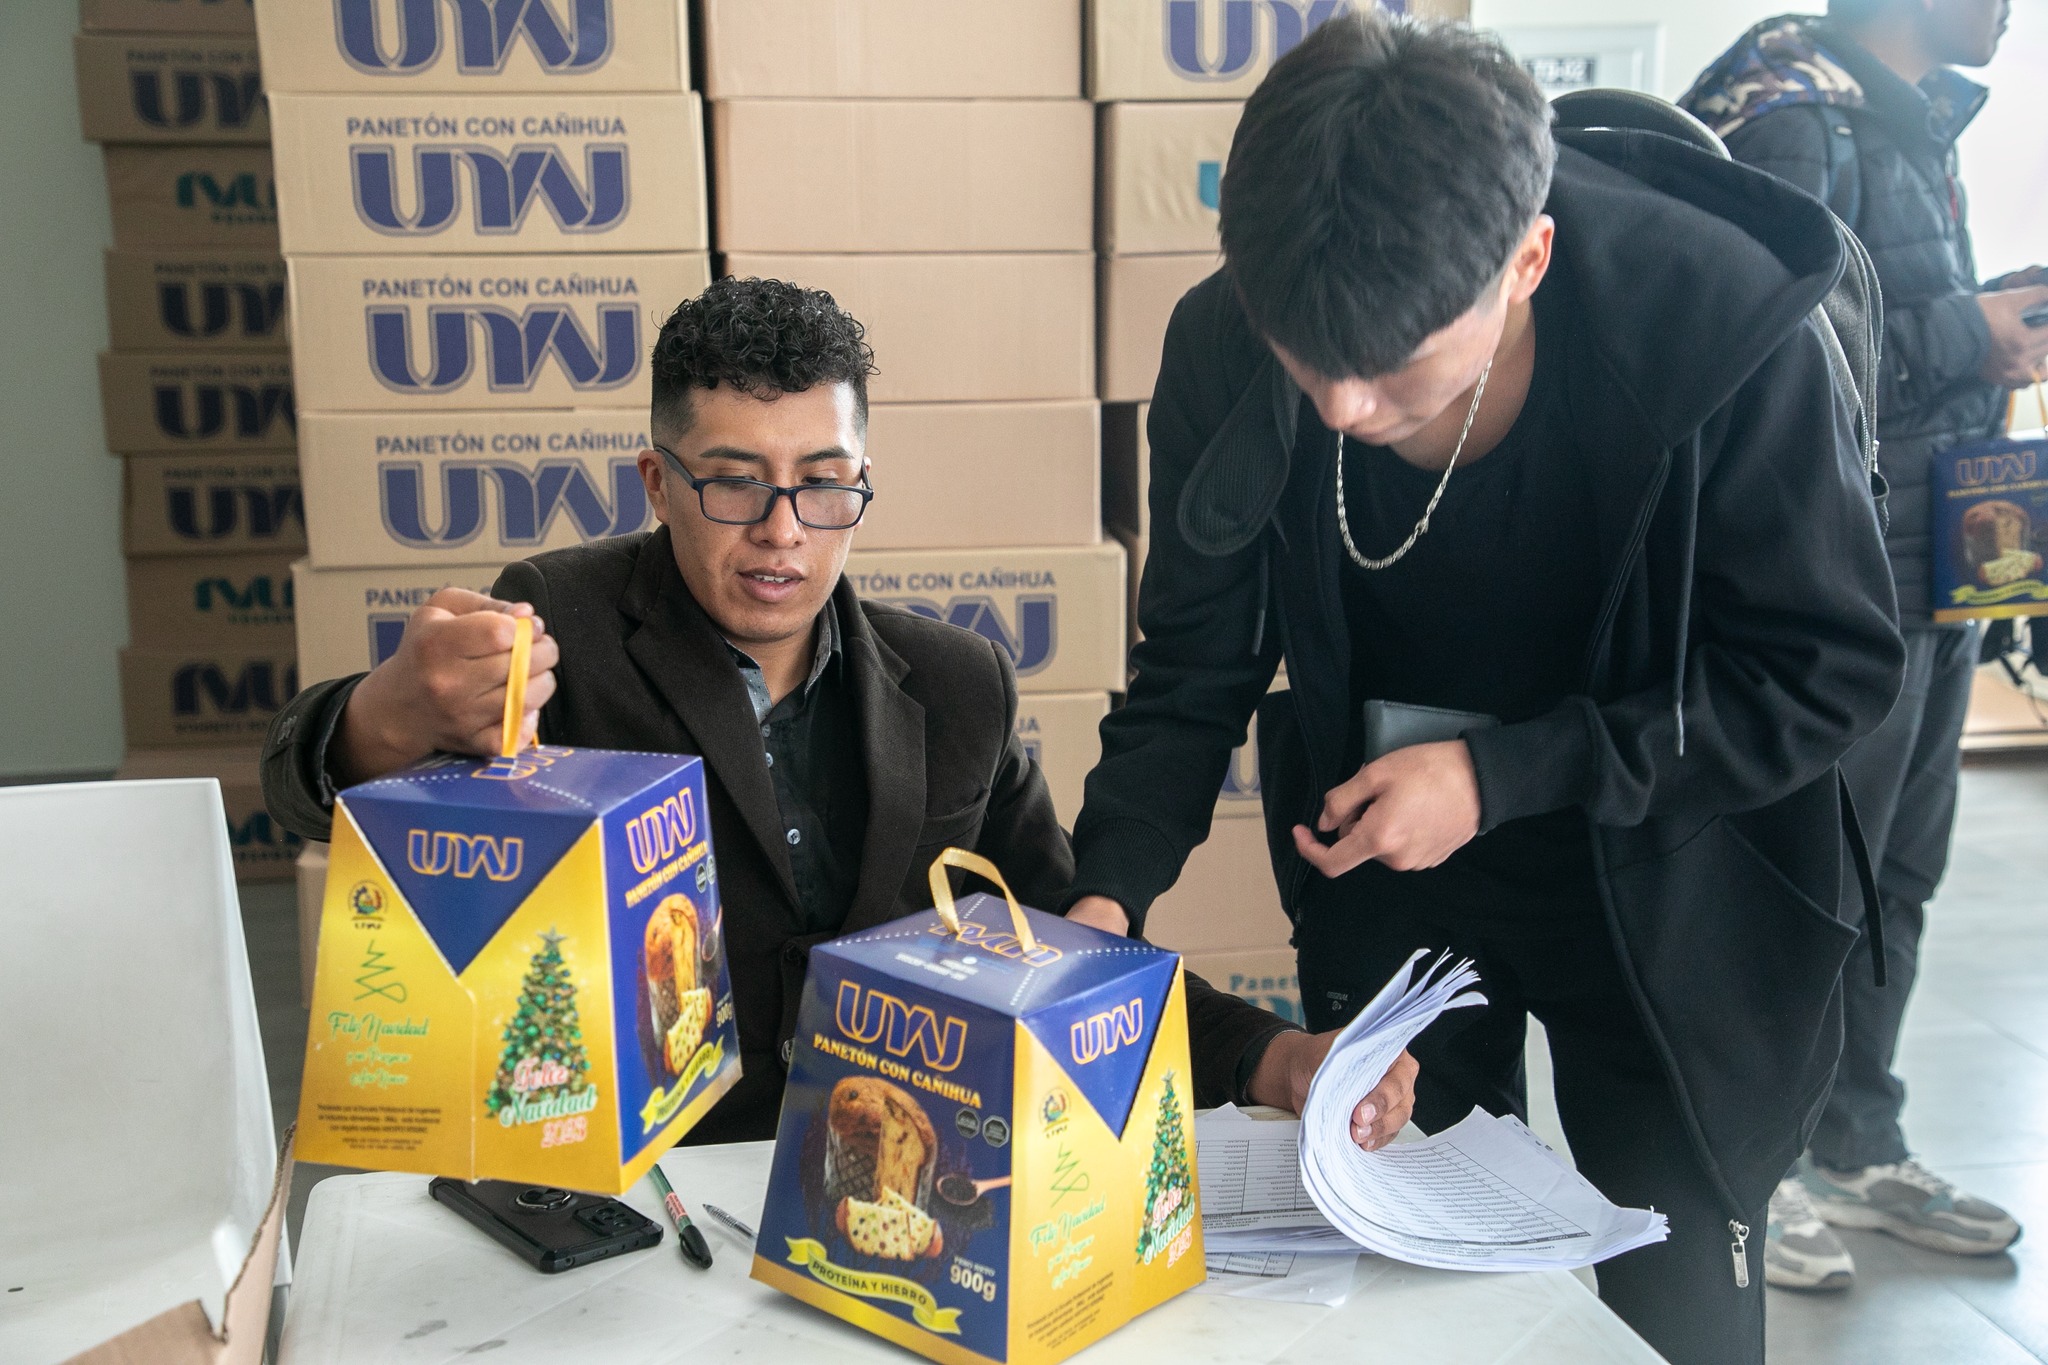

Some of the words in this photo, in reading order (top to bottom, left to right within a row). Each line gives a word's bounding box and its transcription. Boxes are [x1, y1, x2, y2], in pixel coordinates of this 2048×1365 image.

[346, 112, 458, 137] PANETÓN
[464, 116, 516, 137] CON
[522, 112, 628, 137] CAÑIHUA
[362, 274, 472, 298] PANETÓN
[478, 277, 530, 297] CON
[535, 272, 639, 297] CAÑIHUA
[375, 431, 484, 455] PANETÓN
[490, 434, 541, 453] CON
[546, 428, 651, 452] CAÑIHUA
[907, 571, 954, 591] CON
[959, 566, 1056, 589] CAÑIHUA
[361, 1012, 430, 1043] Navidad
[514, 1056, 569, 1092] Feliz
[813, 1033, 878, 1071] PANETÓN
[878, 1057, 910, 1083] CON
[911, 1070, 983, 1109] CAÑIHUA
[499, 1083, 599, 1128] Navidad
[1143, 1192, 1196, 1266] Navidad
[871, 1282, 878, 1291] Y
[881, 1282, 928, 1306] HIERRO
[950, 1263, 997, 1303] 900g
